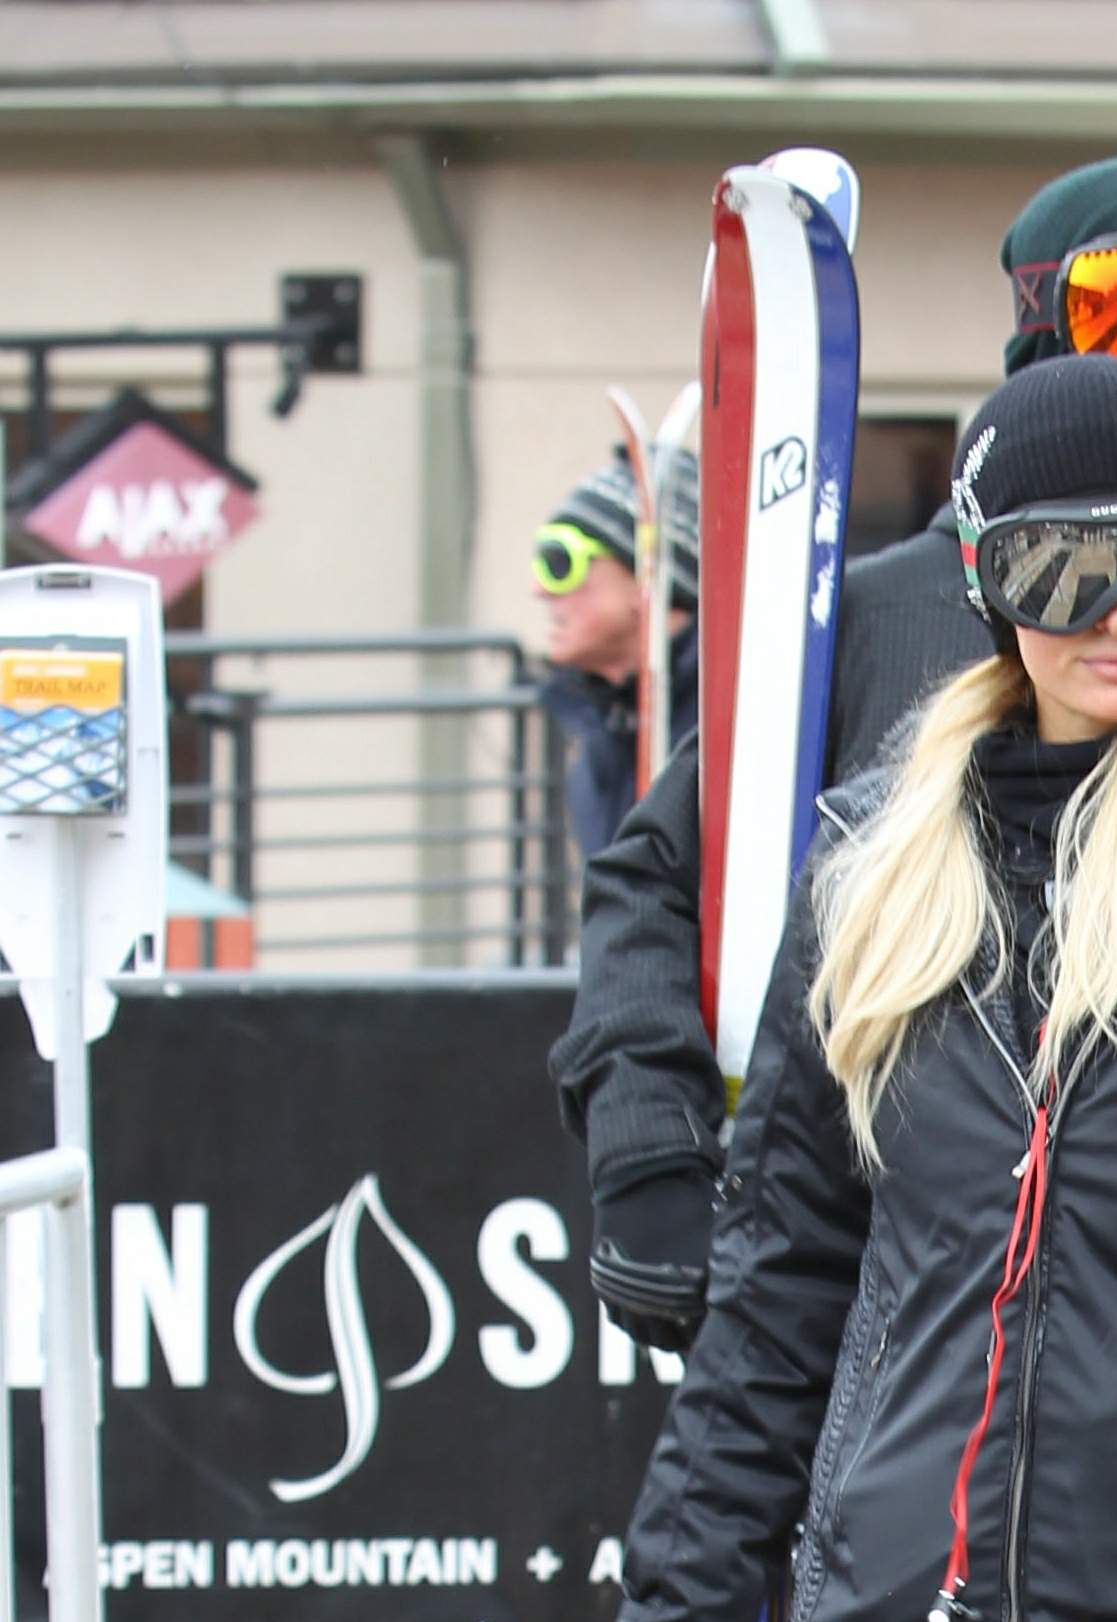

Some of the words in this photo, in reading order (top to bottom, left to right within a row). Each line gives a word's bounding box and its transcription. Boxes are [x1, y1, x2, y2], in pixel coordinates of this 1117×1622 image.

[759, 436, 807, 513] K2
[75, 477, 230, 559] AJAX
[68, 679, 107, 694] MAP
[227, 1539, 497, 1588] MOUNTAIN
[588, 1537, 624, 1585] A
